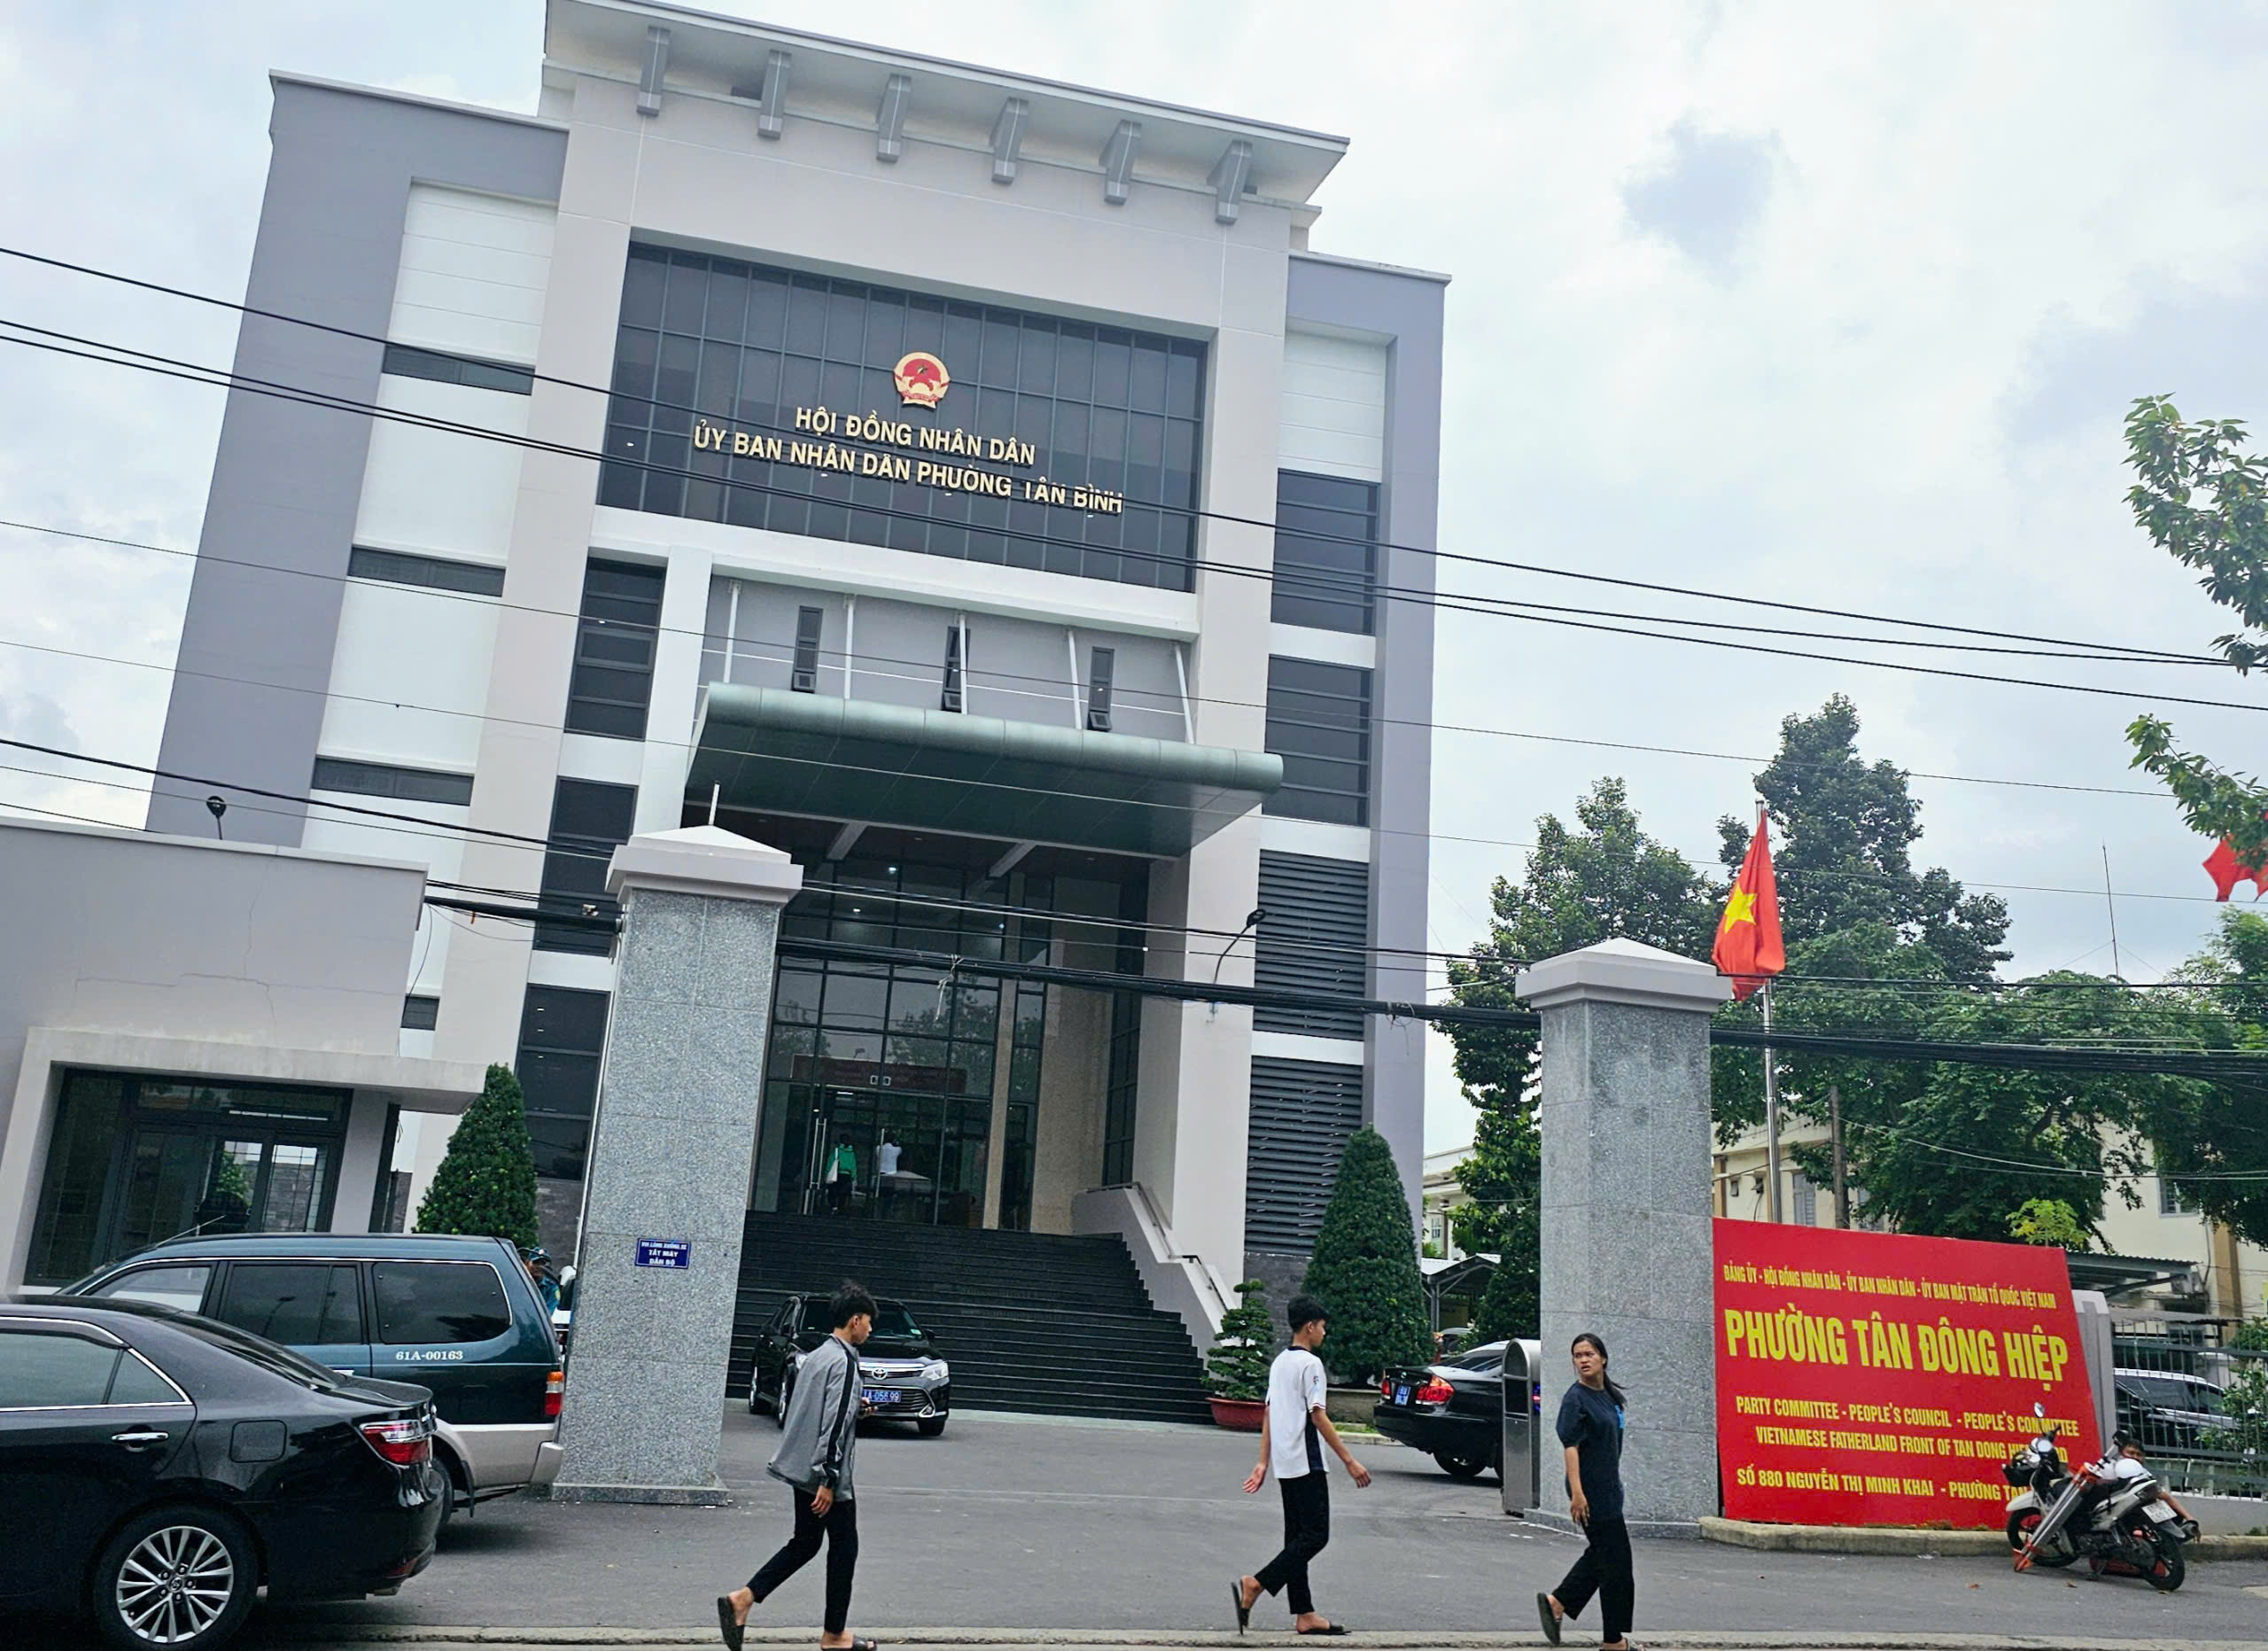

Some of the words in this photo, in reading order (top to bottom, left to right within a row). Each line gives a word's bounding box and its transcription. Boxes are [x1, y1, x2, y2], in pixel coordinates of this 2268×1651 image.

[796, 407, 837, 437] HỘI
[846, 409, 913, 447] ĐỒNG
[919, 426, 983, 457] NHÂN
[989, 437, 1036, 466] DÂN
[694, 419, 726, 451] ỦY
[734, 432, 782, 461] BAN
[790, 442, 856, 472] NHÂN
[862, 453, 911, 481] DÂN
[917, 461, 1013, 497] PHƯỜNG
[1021, 476, 1067, 505] TÂN
[1073, 484, 1123, 514] BÌNH
[1724, 1259, 1745, 1282] ĐẢNG
[1746, 1262, 1757, 1283] ỦY
[1763, 1266, 1778, 1289] HỘI
[1778, 1265, 1801, 1288] ĐỒNG
[1801, 1269, 1824, 1289] NHÂN
[1824, 1270, 1842, 1290] DÂN
[1846, 1270, 1858, 1291] ỦY
[1858, 1276, 1876, 1294] BAN
[1876, 1276, 1899, 1295] NHÂN
[1899, 1277, 1916, 1297] DÂN
[1921, 1277, 1932, 1298] ỦY
[1932, 1282, 1950, 1299] BAN
[1967, 1283, 1989, 1306] TRẬN
[2000, 1285, 2021, 1306] QUỐC
[2020, 1288, 2037, 1311] VIỆT
[2037, 1292, 2056, 1309] NAM
[396, 1351, 463, 1360] 61A-00163
[1724, 1303, 1849, 1365] PHƯỜNG
[1852, 1311, 1914, 1370] TÂN
[1916, 1316, 2000, 1377] ĐÔNG
[2003, 1324, 2069, 1391] HIỆP
[1736, 1396, 1771, 1415] PARTY
[1774, 1398, 1840, 1420] COMMITTEE
[1848, 1402, 1902, 1424] PEOPLE'S
[1904, 1407, 1952, 1428] COUNCIL
[1963, 1410, 2016, 1432] PEOPLE'S
[1755, 1426, 1829, 1448] VIETNAMESE
[1829, 1430, 1898, 1452] FATHERLAND
[1899, 1435, 1935, 1454] FRONT
[1937, 1438, 1951, 1455] OF
[1953, 1439, 1975, 1458] TAN
[1976, 1441, 2007, 1460] DONG
[1736, 1463, 1755, 1486] SỐ
[1759, 1469, 1783, 1488] 880
[1785, 1468, 1839, 1491] NGUYỄN
[1841, 1475, 1862, 1496] THỊ
[1865, 1476, 1901, 1494] MINH
[1903, 1478, 1934, 1497] KHAI
[1948, 1479, 2001, 1501] PHƯỜNG
